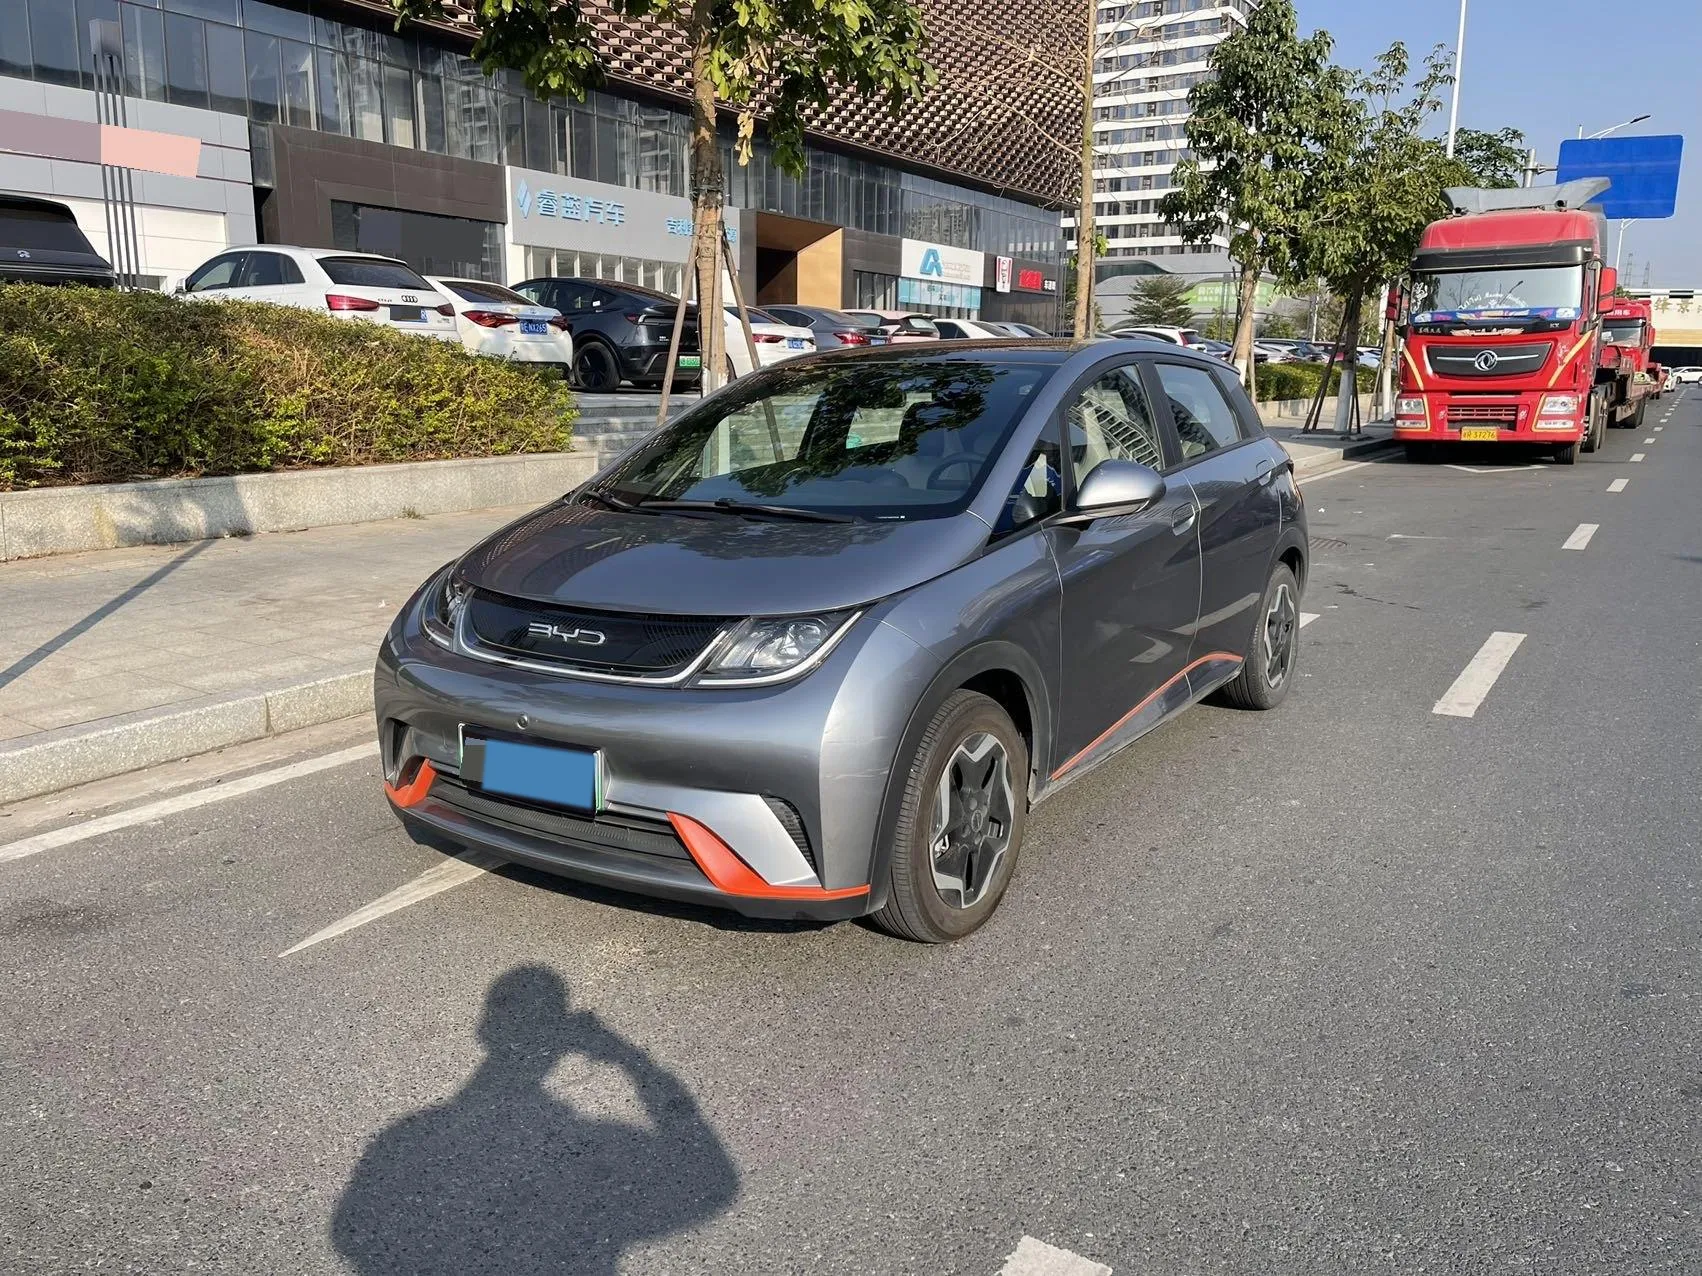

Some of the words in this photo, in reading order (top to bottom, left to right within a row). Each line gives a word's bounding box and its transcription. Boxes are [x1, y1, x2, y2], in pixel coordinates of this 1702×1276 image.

[536, 189, 625, 227] 睿蓝汽车
[527, 621, 606, 645] BYD
